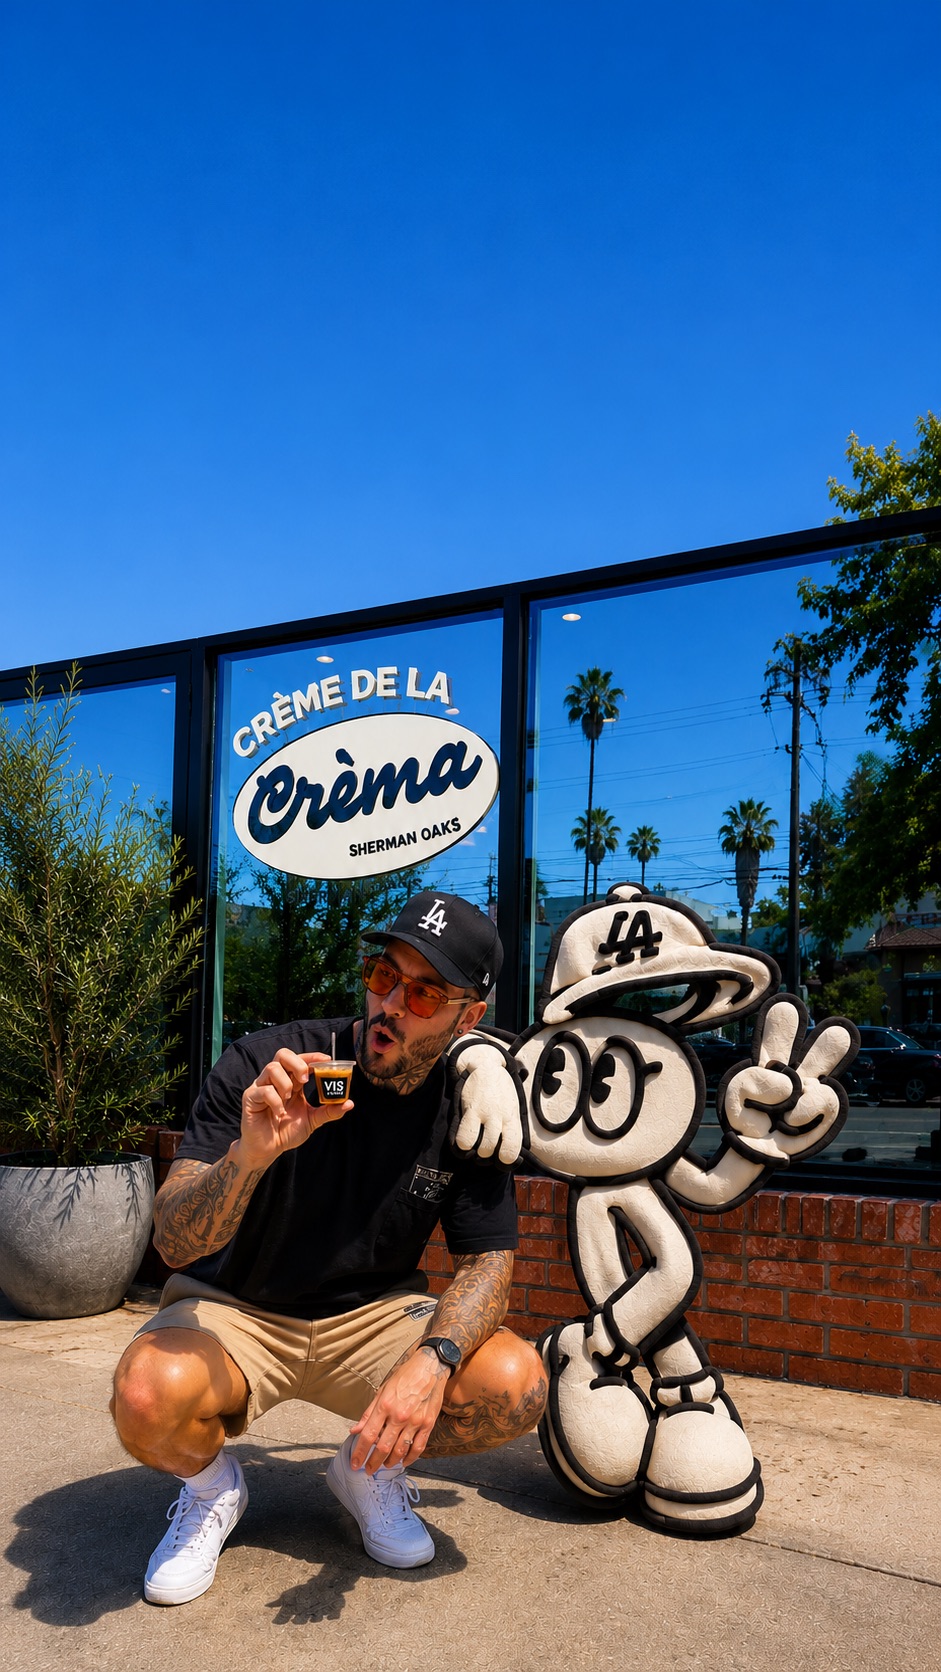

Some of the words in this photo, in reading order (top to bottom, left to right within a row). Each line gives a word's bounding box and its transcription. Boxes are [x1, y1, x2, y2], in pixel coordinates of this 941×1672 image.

[233, 674, 347, 758] CRÈME
[351, 666, 400, 701] DE
[406, 667, 451, 706] LA
[247, 740, 484, 845] Crèma
[349, 830, 418, 857] SHERMAN
[420, 817, 462, 841] OAKS
[418, 898, 448, 937] LA
[324, 1080, 344, 1092] VIS
